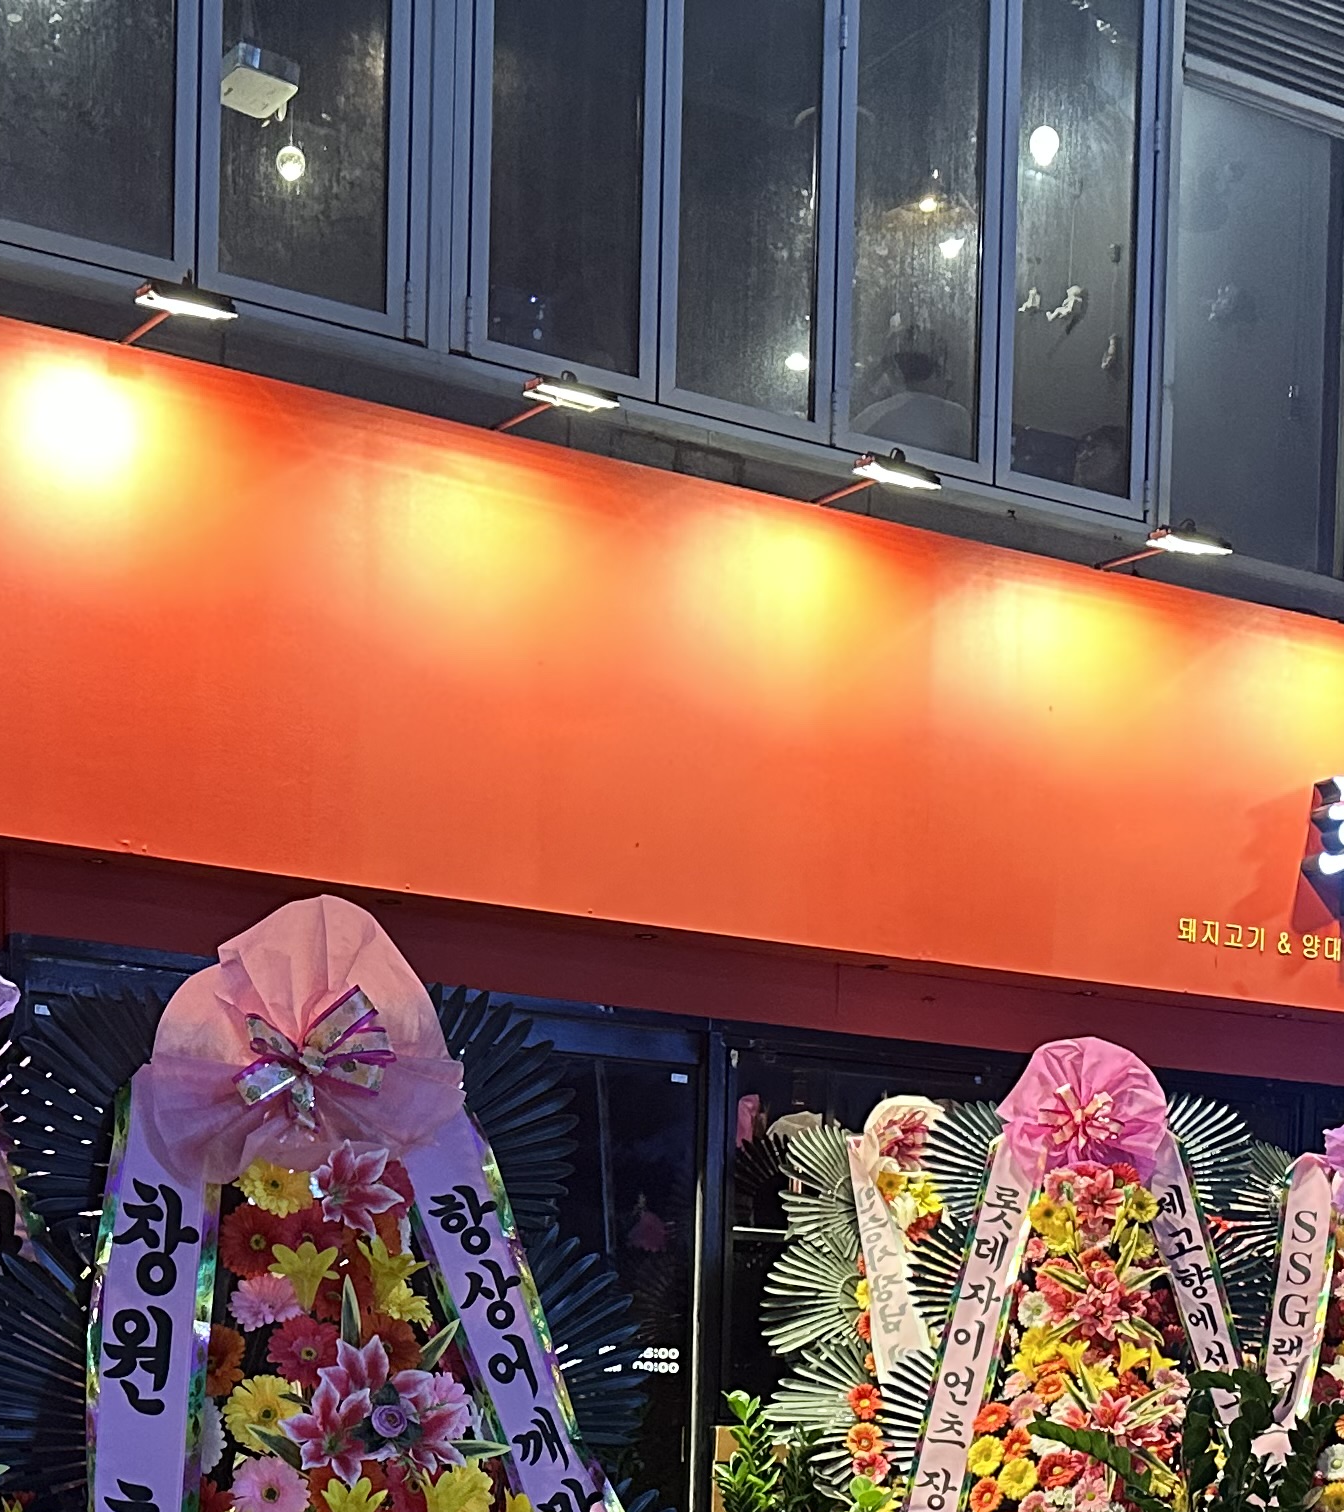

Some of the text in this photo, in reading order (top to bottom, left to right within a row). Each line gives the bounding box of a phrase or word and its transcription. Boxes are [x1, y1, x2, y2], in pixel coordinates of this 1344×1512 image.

[1177, 918, 1267, 953] 돼지고기
[1277, 932, 1294, 956] &
[102, 1176, 199, 1416] 창원
[925, 1185, 1023, 1450] 롯데자이언츠
